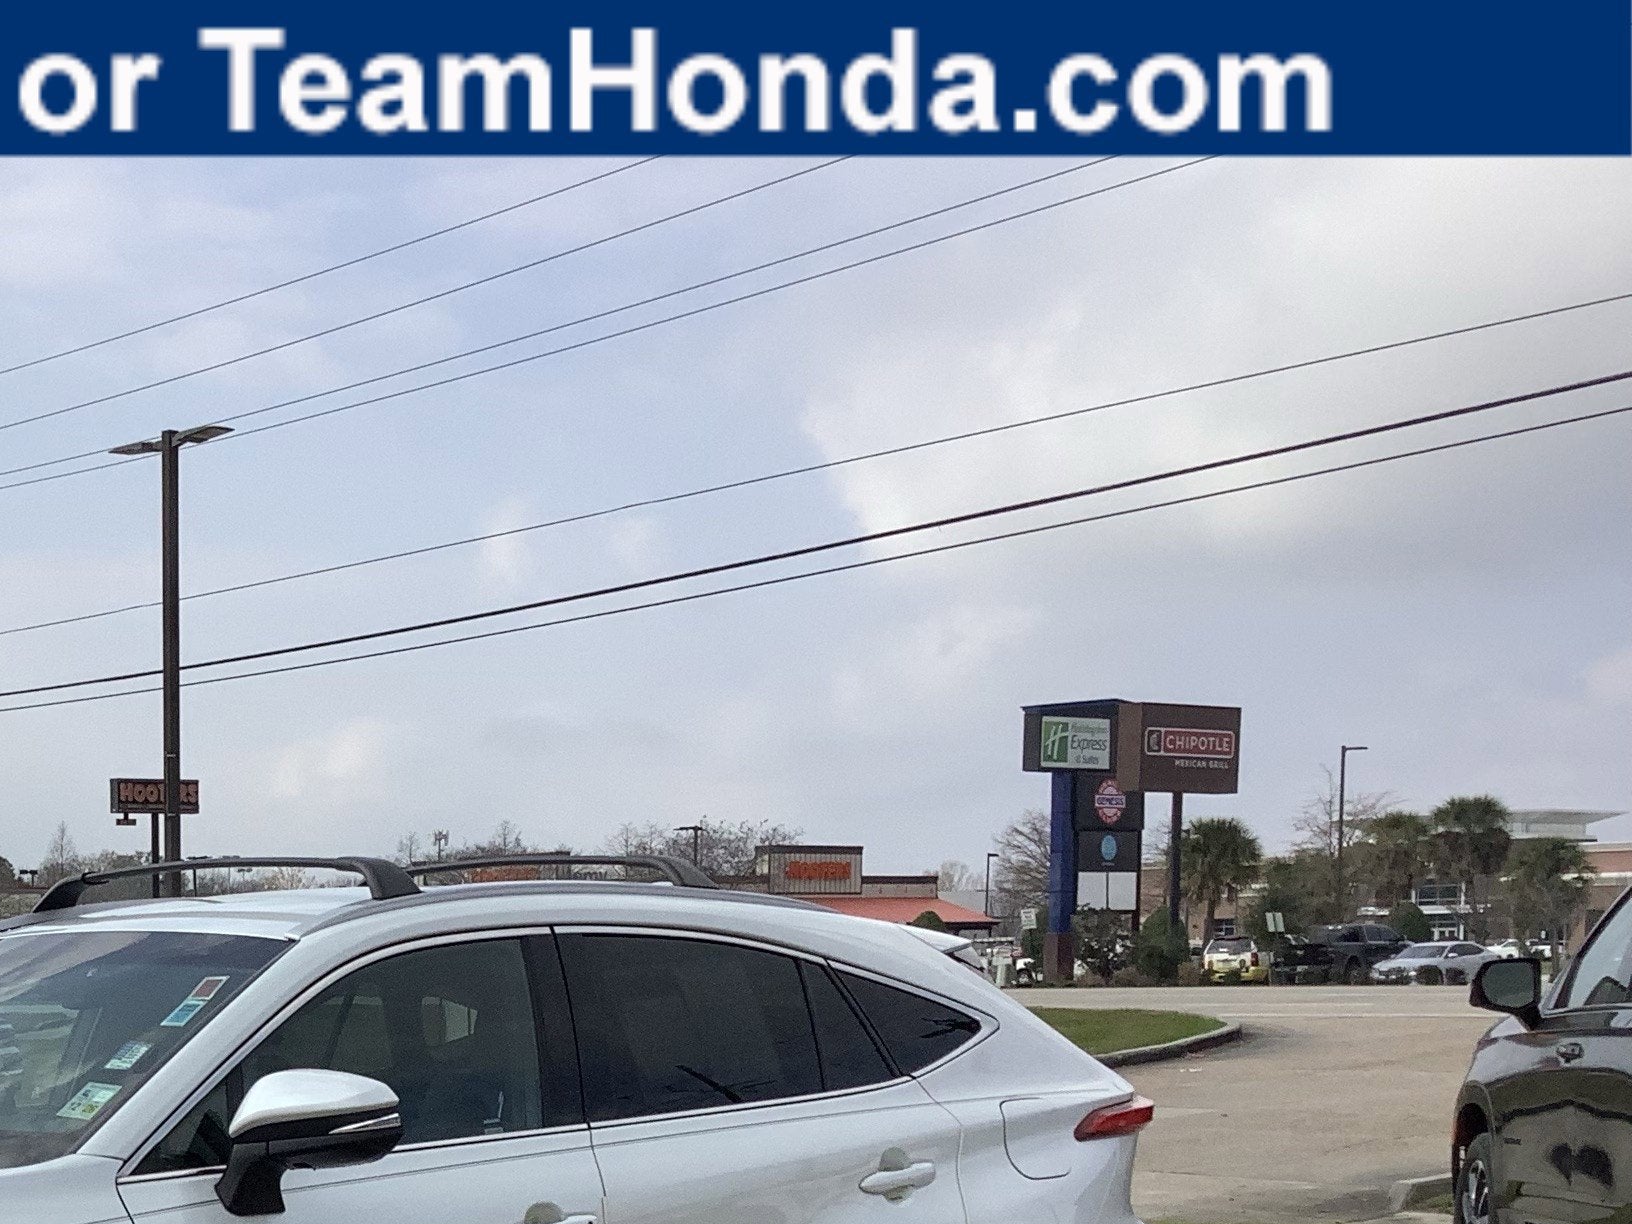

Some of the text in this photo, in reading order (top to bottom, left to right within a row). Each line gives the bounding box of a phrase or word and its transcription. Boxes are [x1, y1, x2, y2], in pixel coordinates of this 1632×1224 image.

[1070, 734, 1108, 755] Express
[1165, 735, 1231, 752] CHIPOTLE
[1174, 759, 1207, 769] MEXICAN
[119, 782, 198, 803] HOOTRS
